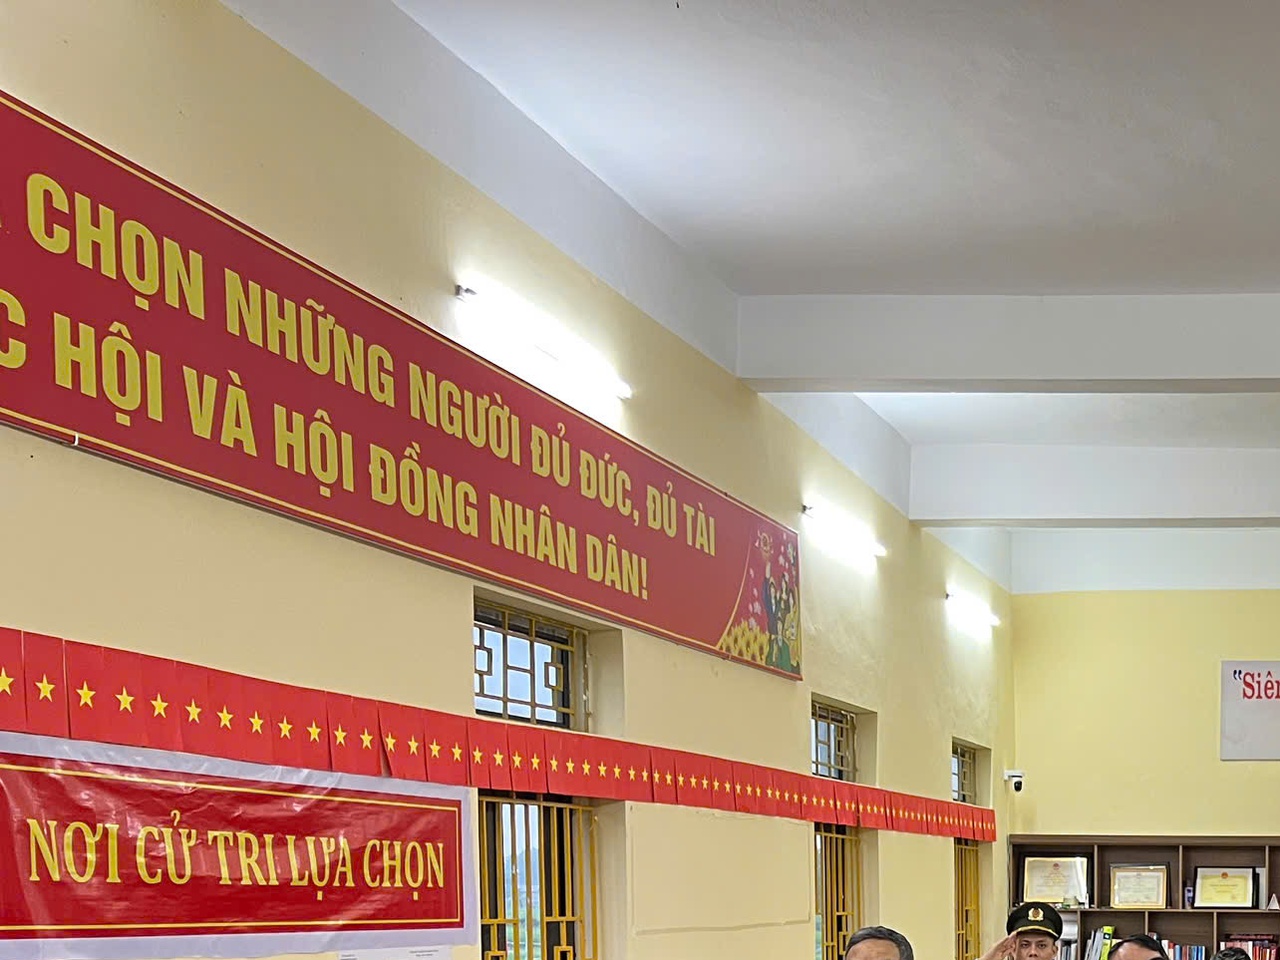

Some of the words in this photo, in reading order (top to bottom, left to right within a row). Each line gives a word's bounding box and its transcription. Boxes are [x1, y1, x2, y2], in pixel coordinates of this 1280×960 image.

[27, 173, 204, 320] CHỌN
[225, 267, 394, 407] NHỮNG
[410, 369, 520, 461] NGƯỜI
[531, 423, 570, 488] ĐỦ
[580, 448, 640, 524] ĐỨC,
[647, 482, 677, 538] ĐỦ
[685, 508, 715, 557] TÀI
[54, 312, 162, 430] HỘI
[182, 366, 257, 457] VÀ
[275, 408, 354, 500] HỘI
[370, 445, 479, 538] ĐỒNG
[490, 495, 577, 575] NHÂN
[587, 536, 649, 600] DÂN!
[28, 819, 121, 882] NƠI
[136, 810, 196, 884] CỬ
[208, 831, 279, 885] TRI
[286, 829, 354, 900] LỰA
[364, 840, 443, 900] CHỌN
